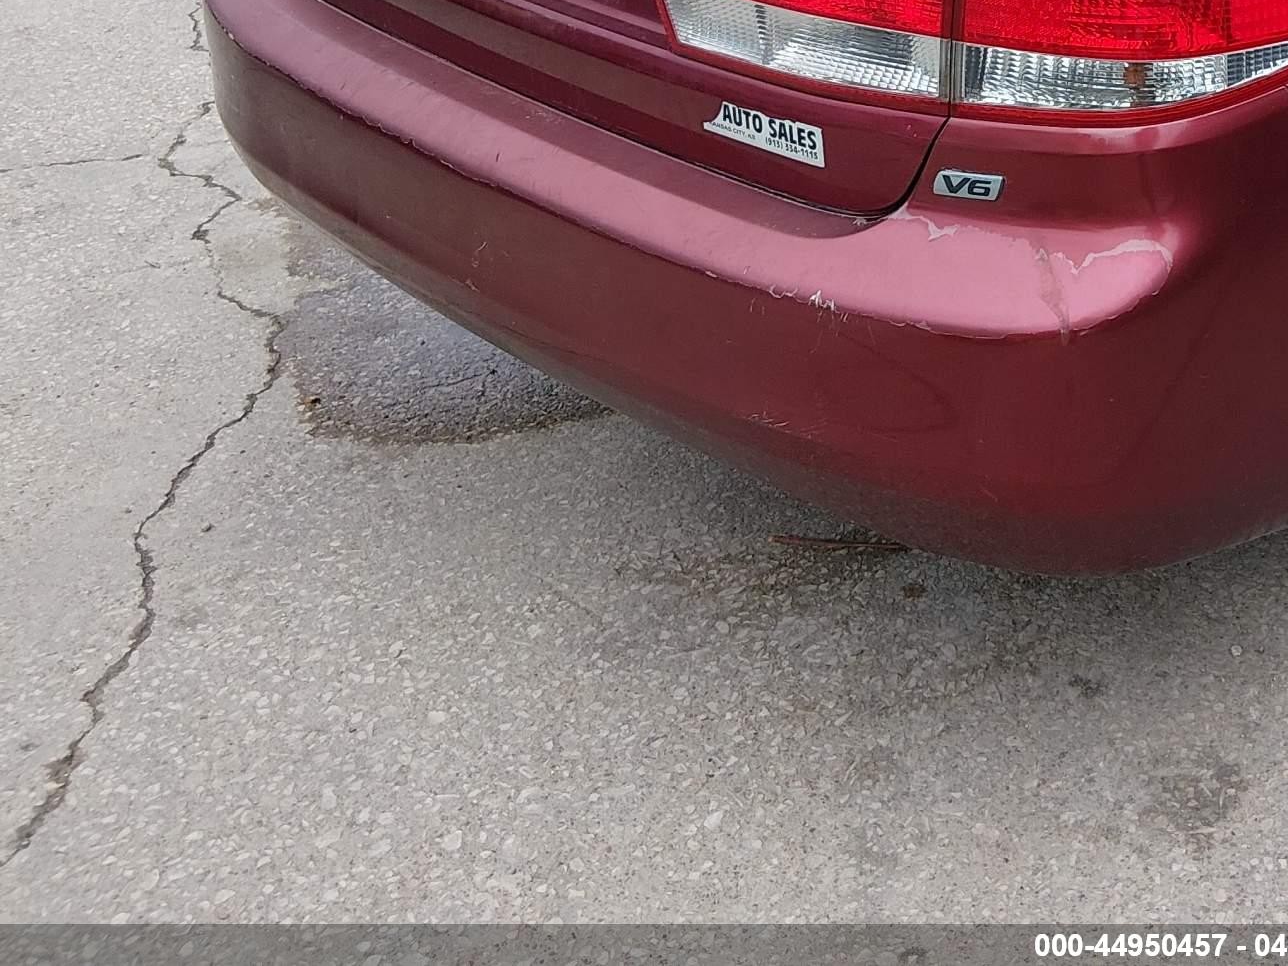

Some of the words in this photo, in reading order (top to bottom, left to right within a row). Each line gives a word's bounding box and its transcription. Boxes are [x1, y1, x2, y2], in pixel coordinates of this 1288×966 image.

[722, 104, 763, 133] AUTO
[768, 119, 817, 150] SALES
[766, 137, 783, 149] (913)
[942, 175, 993, 197] V6
